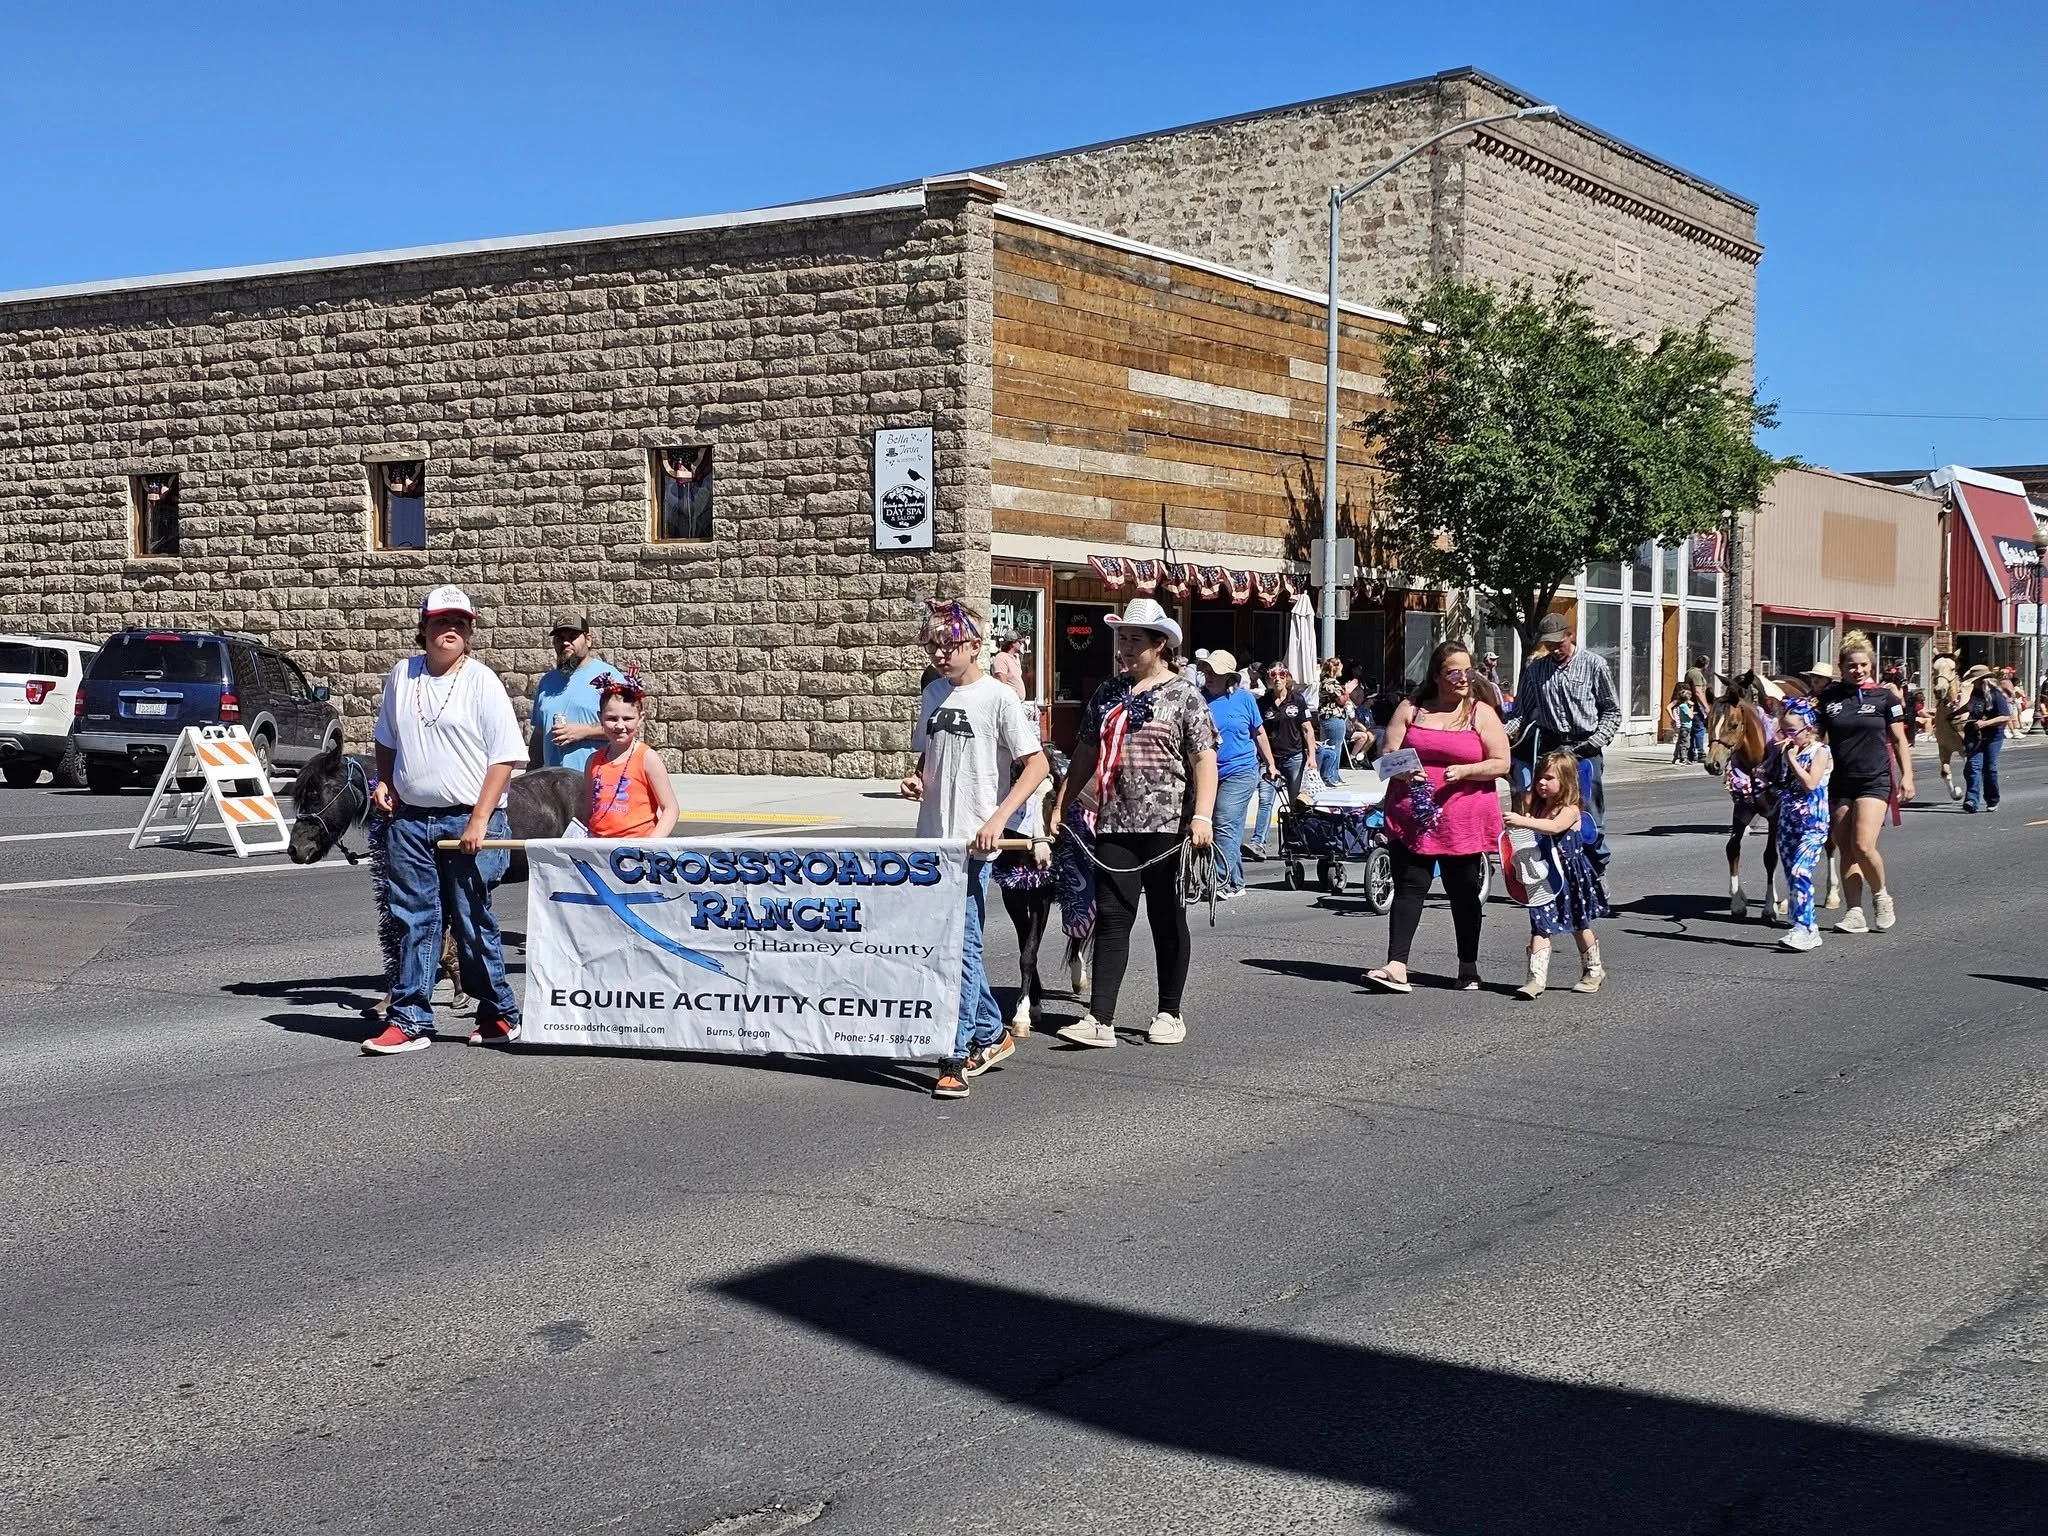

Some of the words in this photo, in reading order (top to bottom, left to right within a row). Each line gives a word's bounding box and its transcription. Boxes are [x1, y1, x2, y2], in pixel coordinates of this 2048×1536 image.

[887, 433, 909, 444] Bella
[886, 508, 904, 516] DAY
[906, 507, 922, 515] SPA
[990, 604, 1014, 630] PEN
[609, 846, 942, 886] CROSSROADS
[689, 891, 861, 932] RANCH
[733, 938, 756, 952] of
[762, 940, 841, 957] Harney
[849, 941, 935, 958] County
[550, 989, 666, 1011] EQUINE
[673, 993, 808, 1014] ACTIVITY
[817, 997, 933, 1019] CENTER
[543, 1022, 665, 1035] crossroadsrhc@gmail.com
[706, 1027, 736, 1038] Burns,
[738, 1027, 771, 1039] Oregon
[834, 1031, 866, 1043] Phone:
[868, 1033, 932, 1045] 541-589-4788
